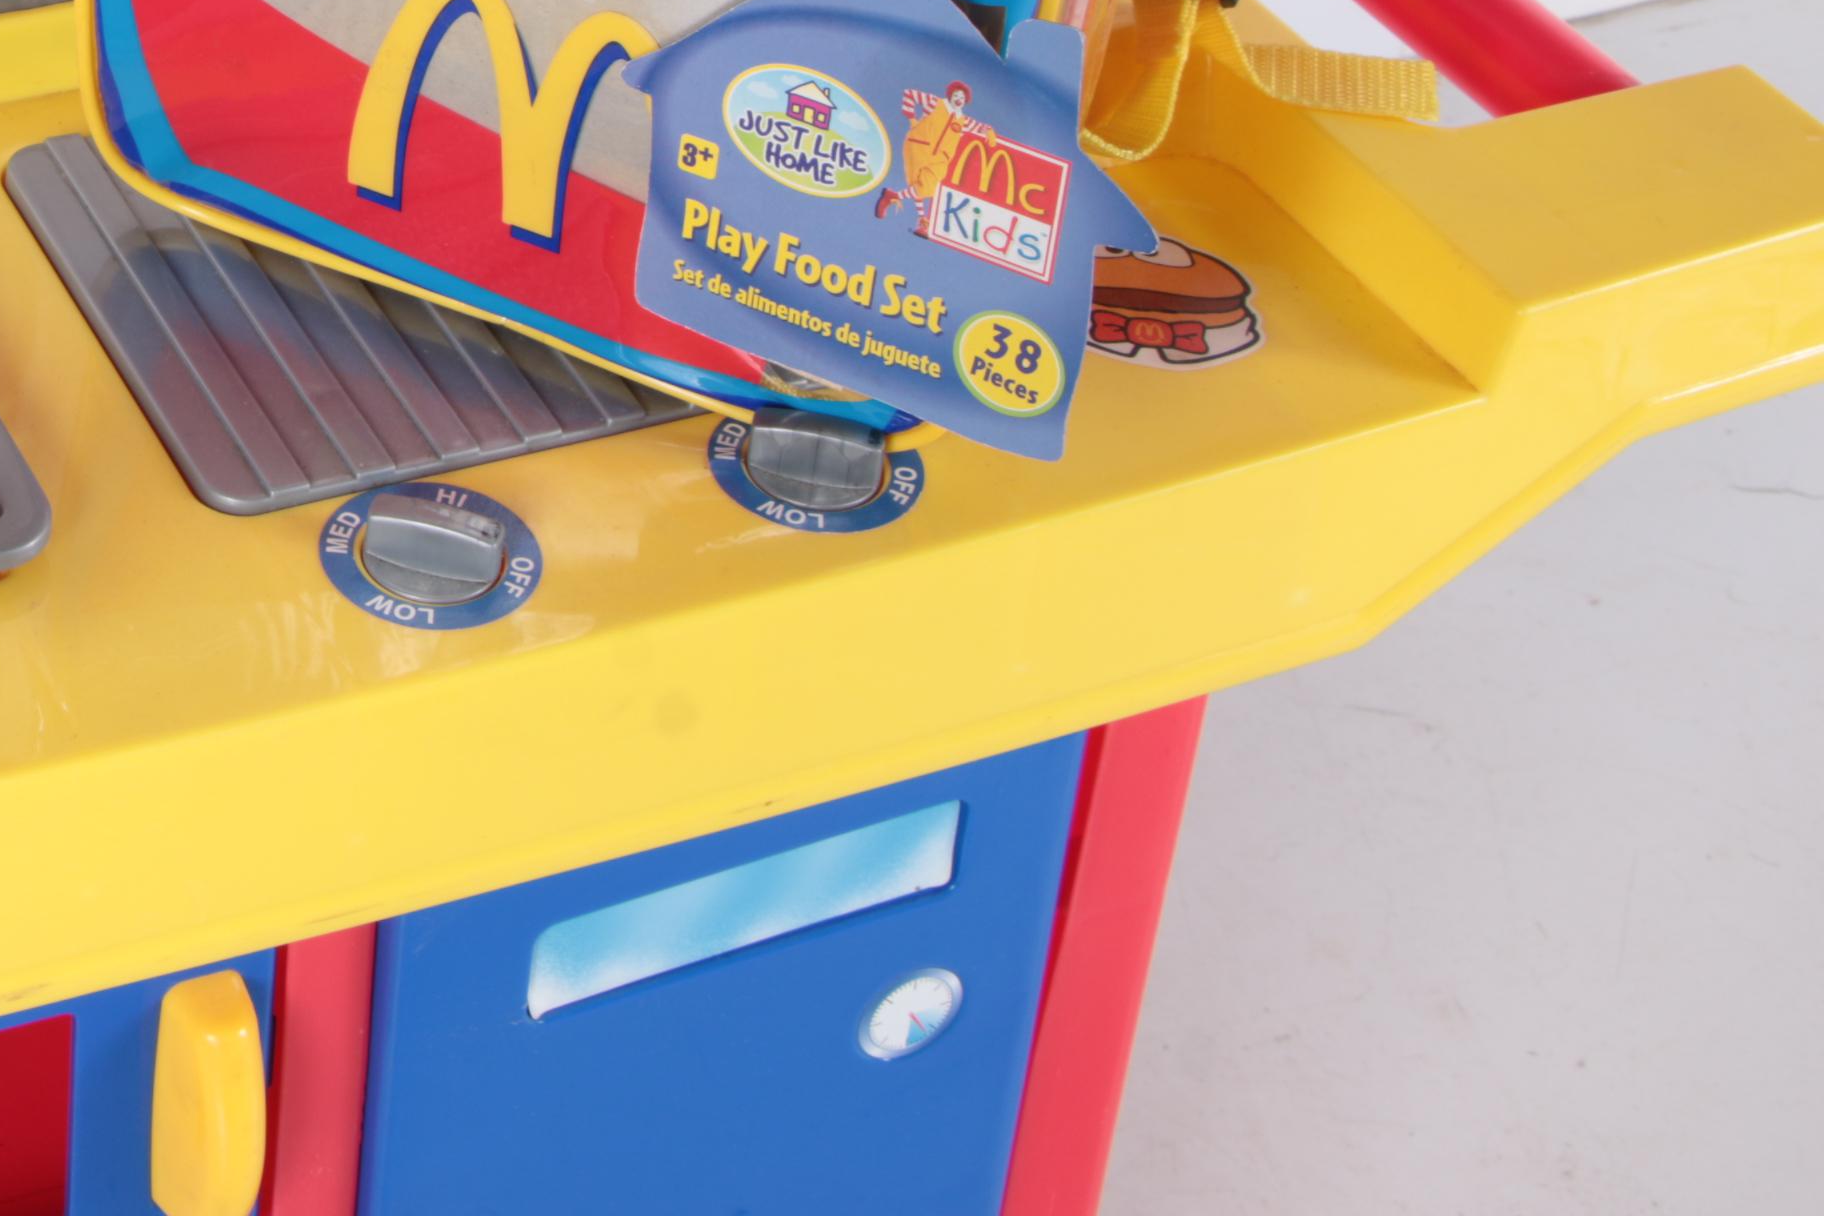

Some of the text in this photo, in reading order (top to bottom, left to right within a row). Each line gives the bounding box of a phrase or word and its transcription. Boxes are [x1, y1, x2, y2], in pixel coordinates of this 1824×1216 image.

[681, 142, 714, 168] 3+
[738, 111, 868, 174] JUST LIKE
[765, 141, 835, 184] HOME
[942, 191, 1042, 262] Kids
[682, 197, 948, 334] Play Food Set
[672, 259, 942, 379] Set de alimentos de juguete
[985, 322, 1042, 375] 38
[971, 355, 1039, 405] Pieces
[714, 422, 747, 462] MED
[436, 487, 468, 508] HI
[888, 466, 917, 507] OFF
[326, 510, 362, 556] MED
[756, 499, 825, 530] LOW
[503, 555, 535, 600] OFF
[364, 593, 436, 626] LOW
